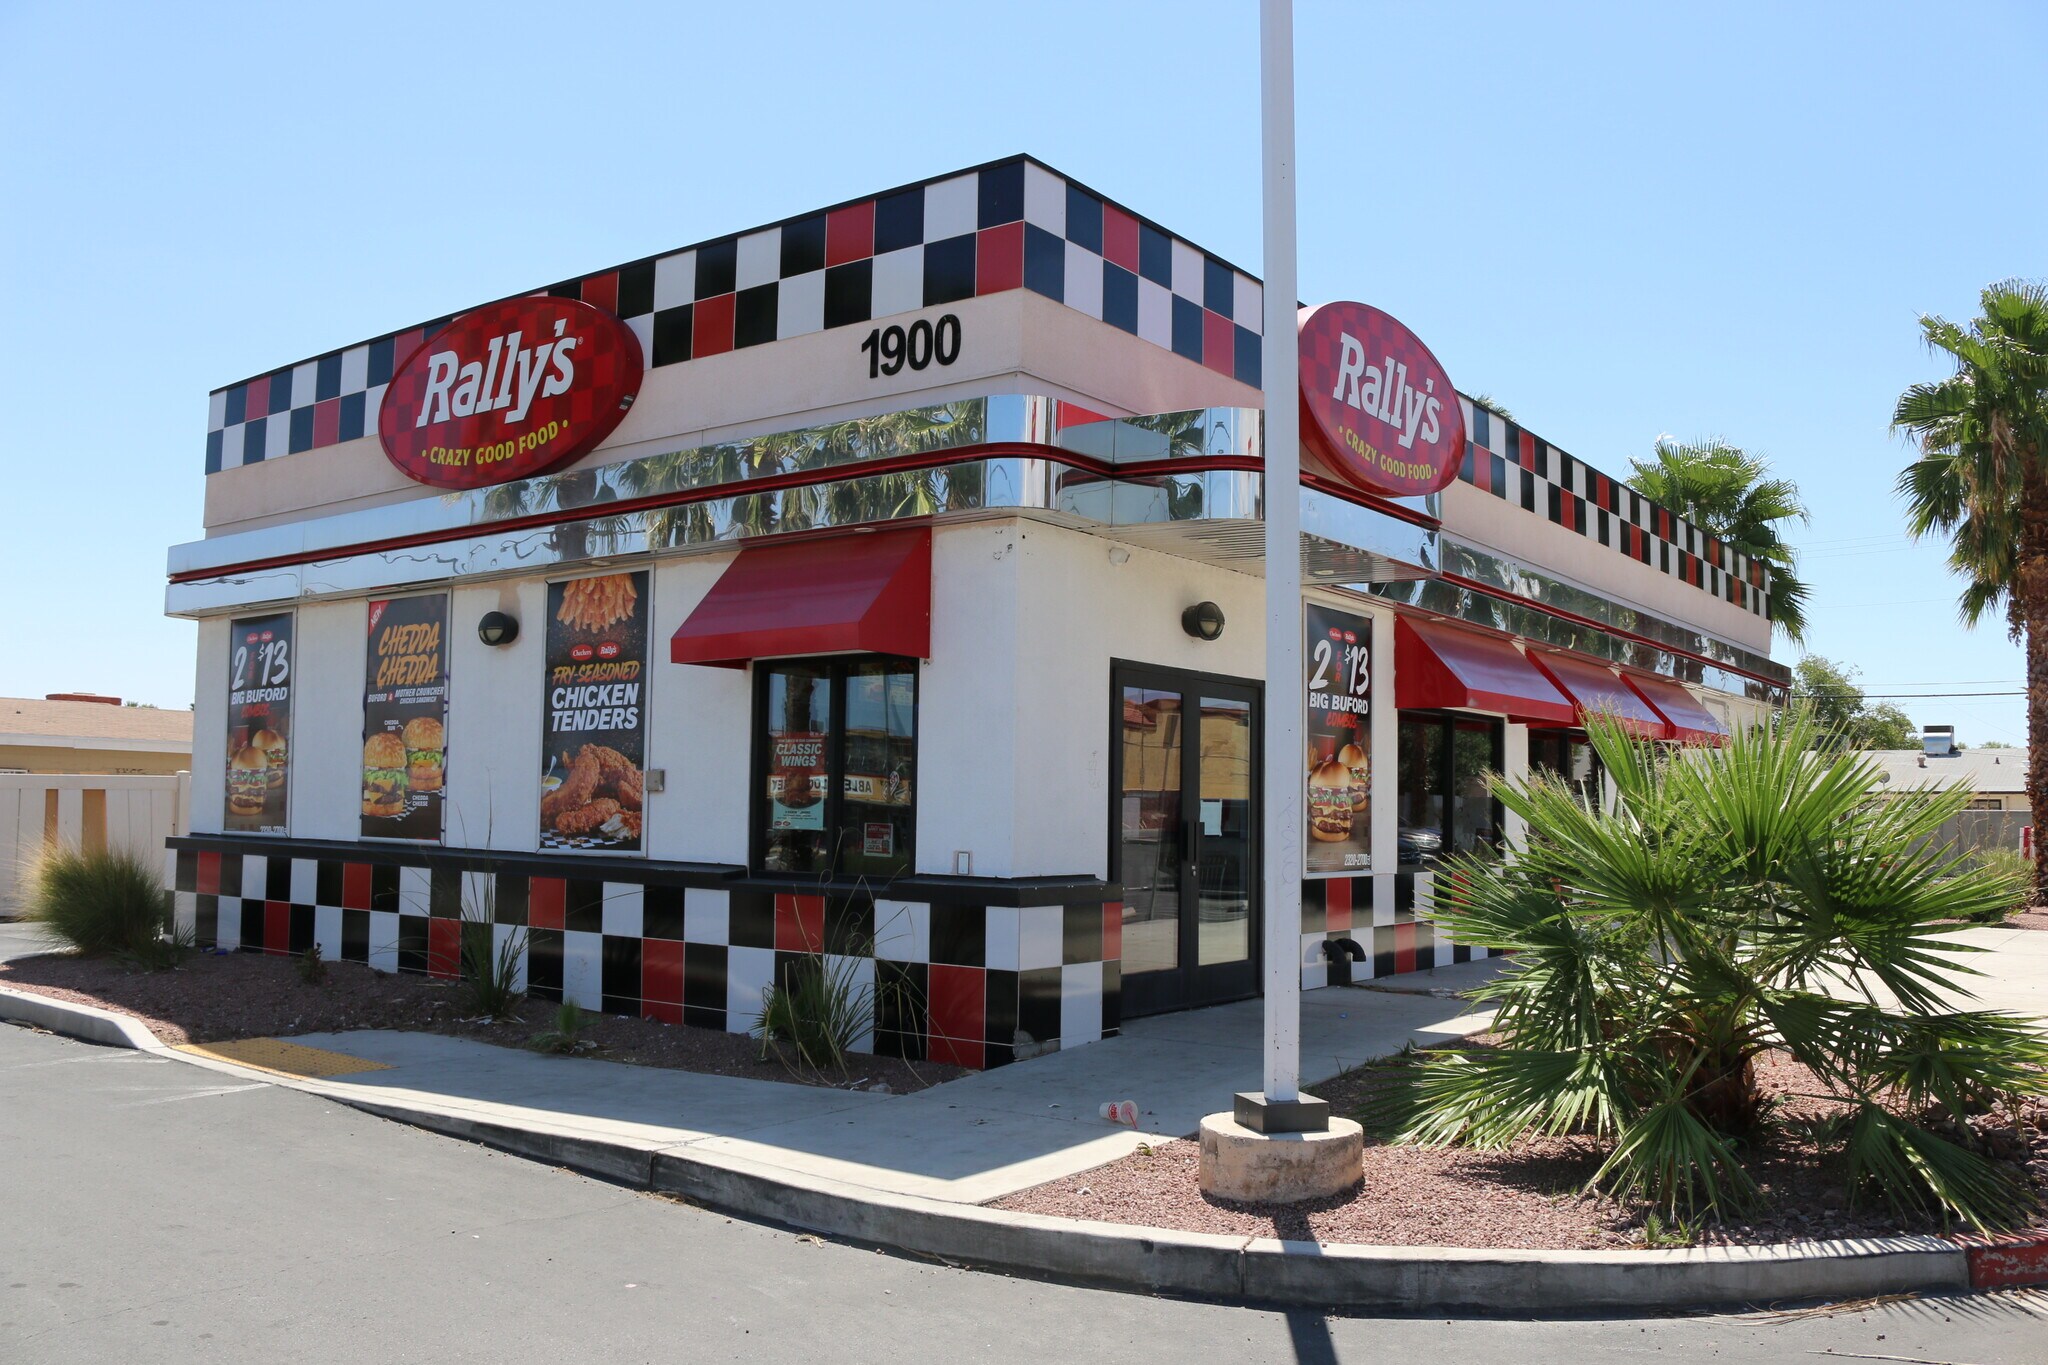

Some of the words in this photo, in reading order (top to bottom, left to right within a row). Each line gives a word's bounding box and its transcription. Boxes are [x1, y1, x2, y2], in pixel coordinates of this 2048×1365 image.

[862, 314, 961, 379] 1900
[416, 318, 577, 428] Rally's
[1333, 332, 1442, 449] Rally's
[430, 446, 471, 466] CRAZY
[476, 441, 515, 465] GOOD
[519, 421, 559, 454] FOOD
[1346, 429, 1377, 464] CRAZY
[1380, 454, 1406, 478] GOOD
[1408, 463, 1432, 480] FOOD
[370, 605, 383, 627] NEW
[378, 621, 440, 656] CHEDDA
[600, 645, 617, 656] Rally's
[231, 646, 248, 690] 2
[258, 640, 289, 687] $13
[377, 653, 439, 689] CHEDDA
[552, 660, 640, 686] FRY-SEASONED
[1309, 639, 1332, 690] 2
[1344, 644, 1369, 695] $13
[231, 690, 245, 705] BIG
[245, 687, 287, 703] BUFORD
[552, 683, 640, 709] CHICKEN
[1309, 692, 1329, 709] BIG
[1331, 694, 1369, 715] BUFORD
[552, 706, 639, 732] TENDERS
[776, 743, 823, 755] CLASSIC
[781, 755, 817, 767] WINGS
